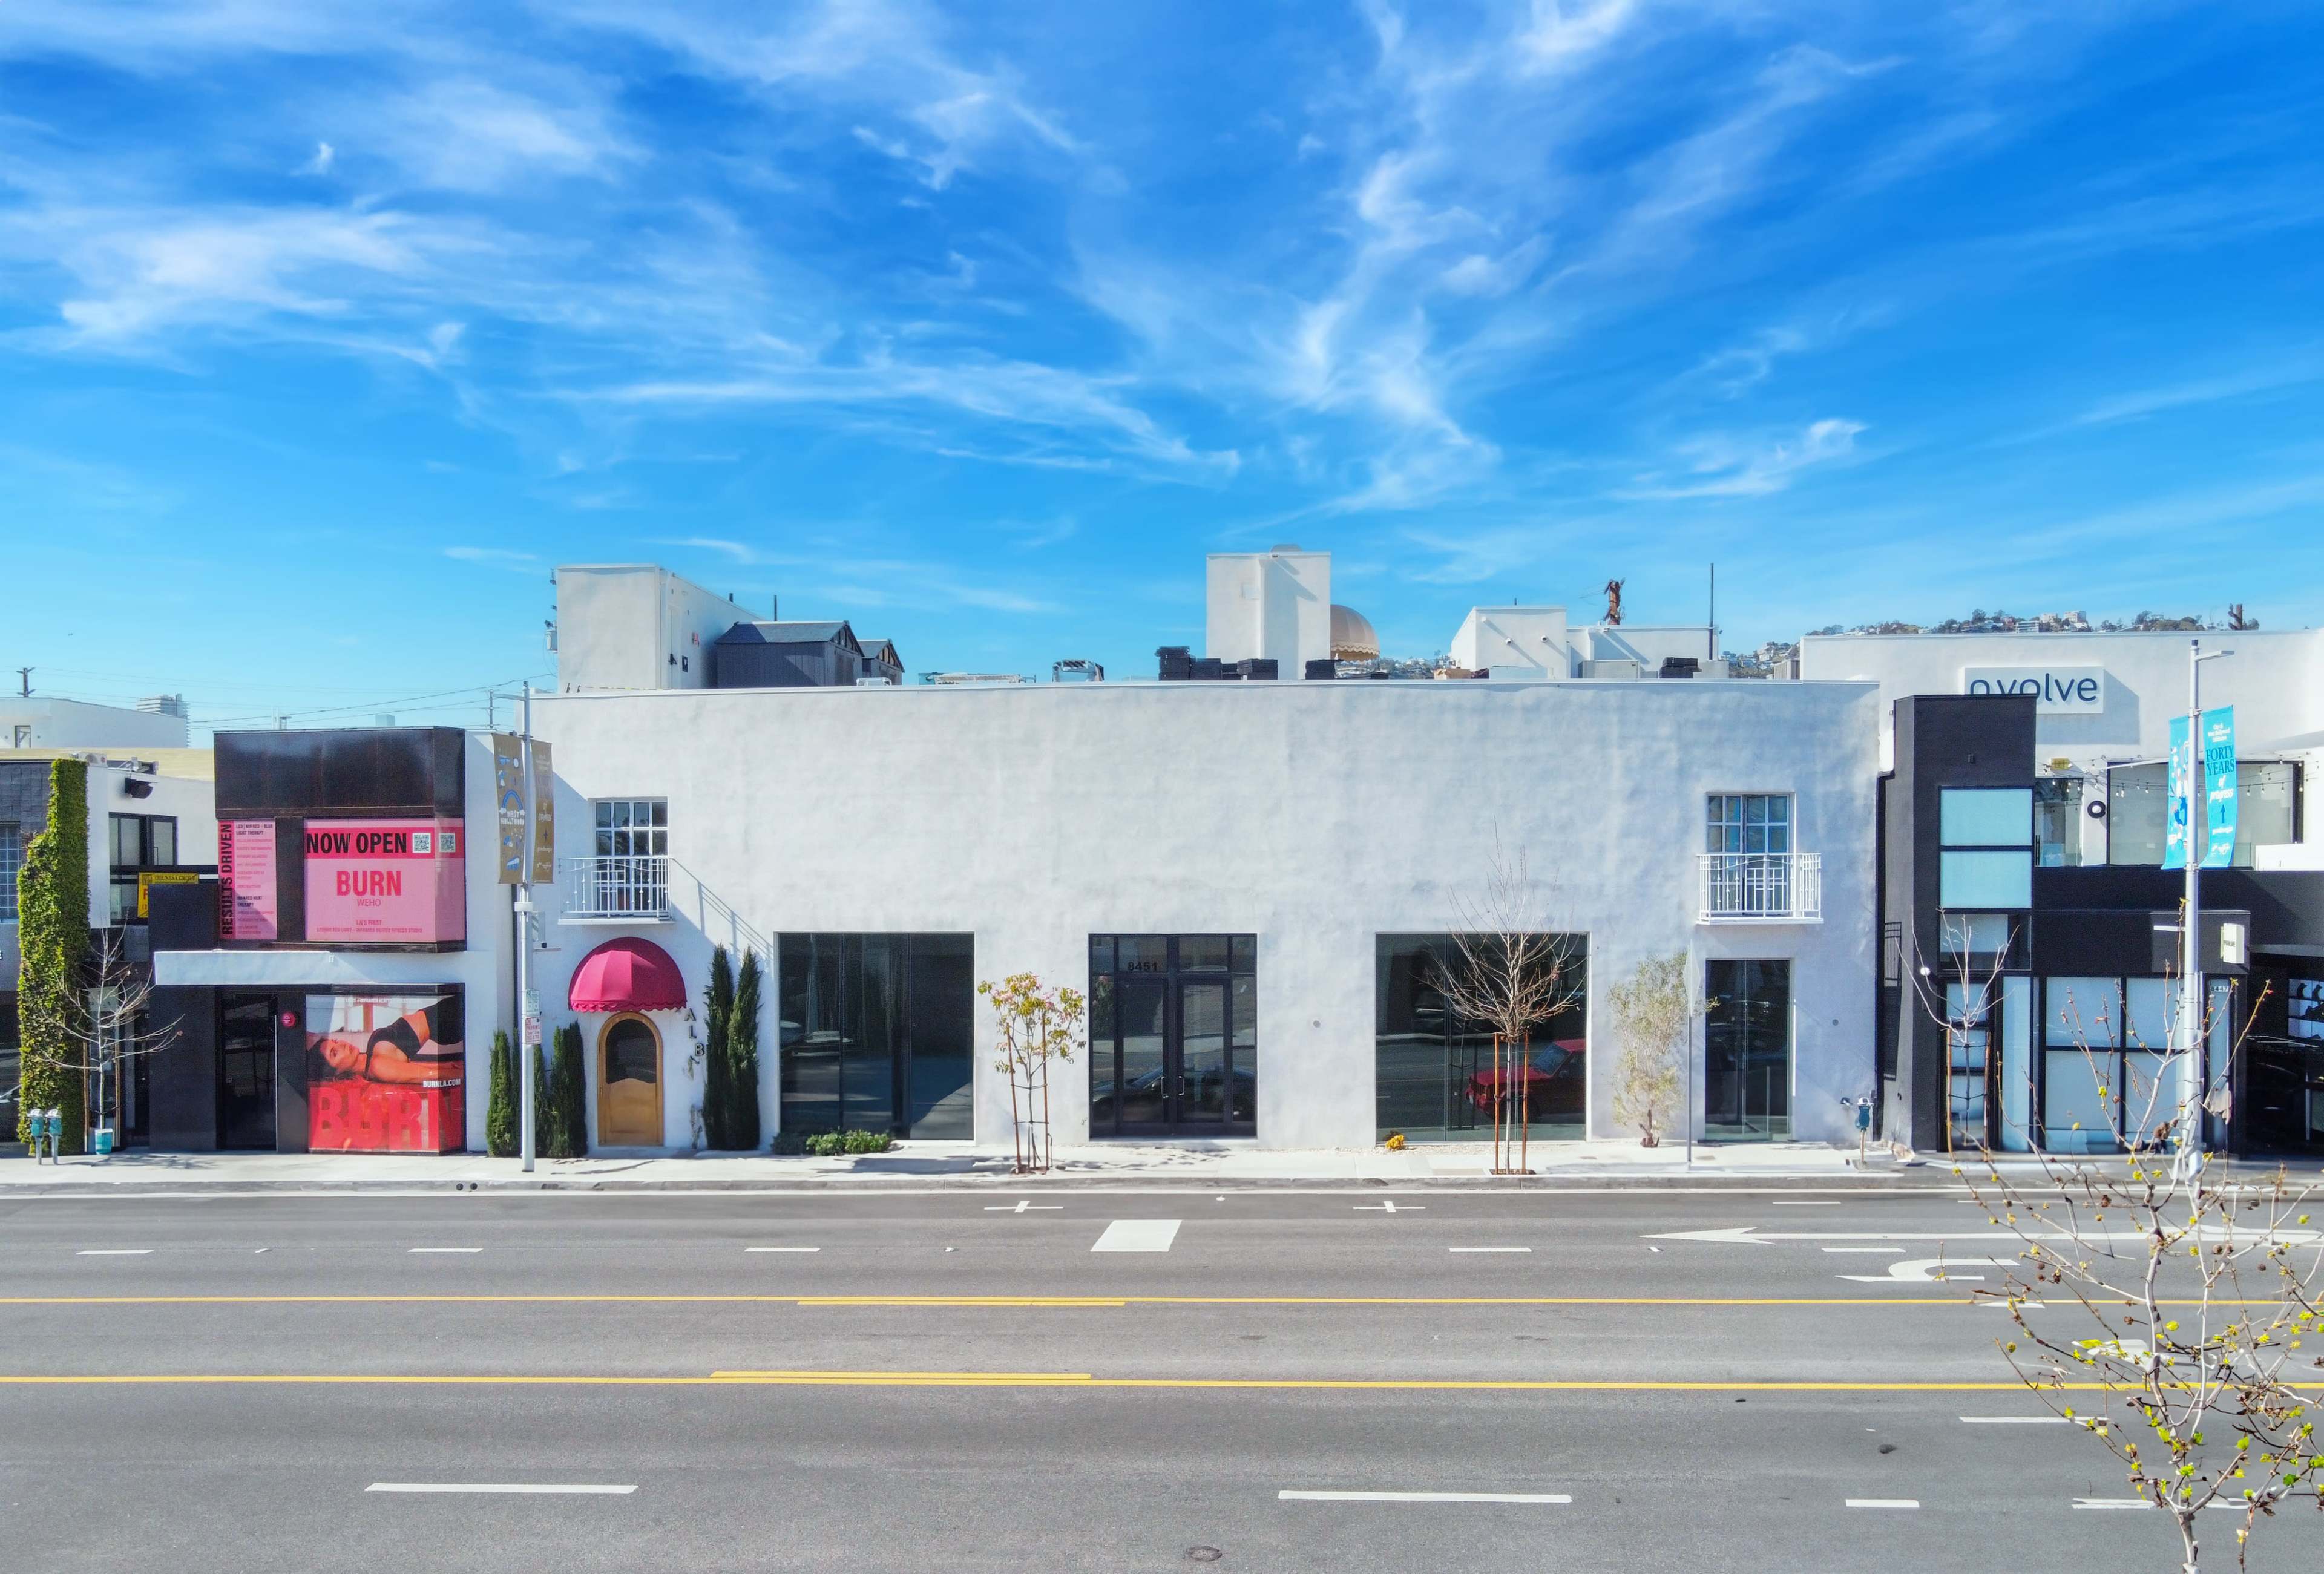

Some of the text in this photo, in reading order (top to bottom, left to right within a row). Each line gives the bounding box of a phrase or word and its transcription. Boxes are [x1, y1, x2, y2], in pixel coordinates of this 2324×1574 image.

[2206, 744, 2234, 762] FORTY
[2207, 759, 2234, 776] YEARS
[2218, 774, 2226, 787] of
[2210, 788, 2234, 803] progress
[307, 833, 407, 853] NOW OPEN
[220, 824, 233, 934] RESULTS DRIVEN
[336, 871, 402, 896] BURN
[1128, 962, 1157, 971] 8451
[422, 1078, 461, 1088] BURNLA.COM
[310, 1087, 463, 1151] BURN
